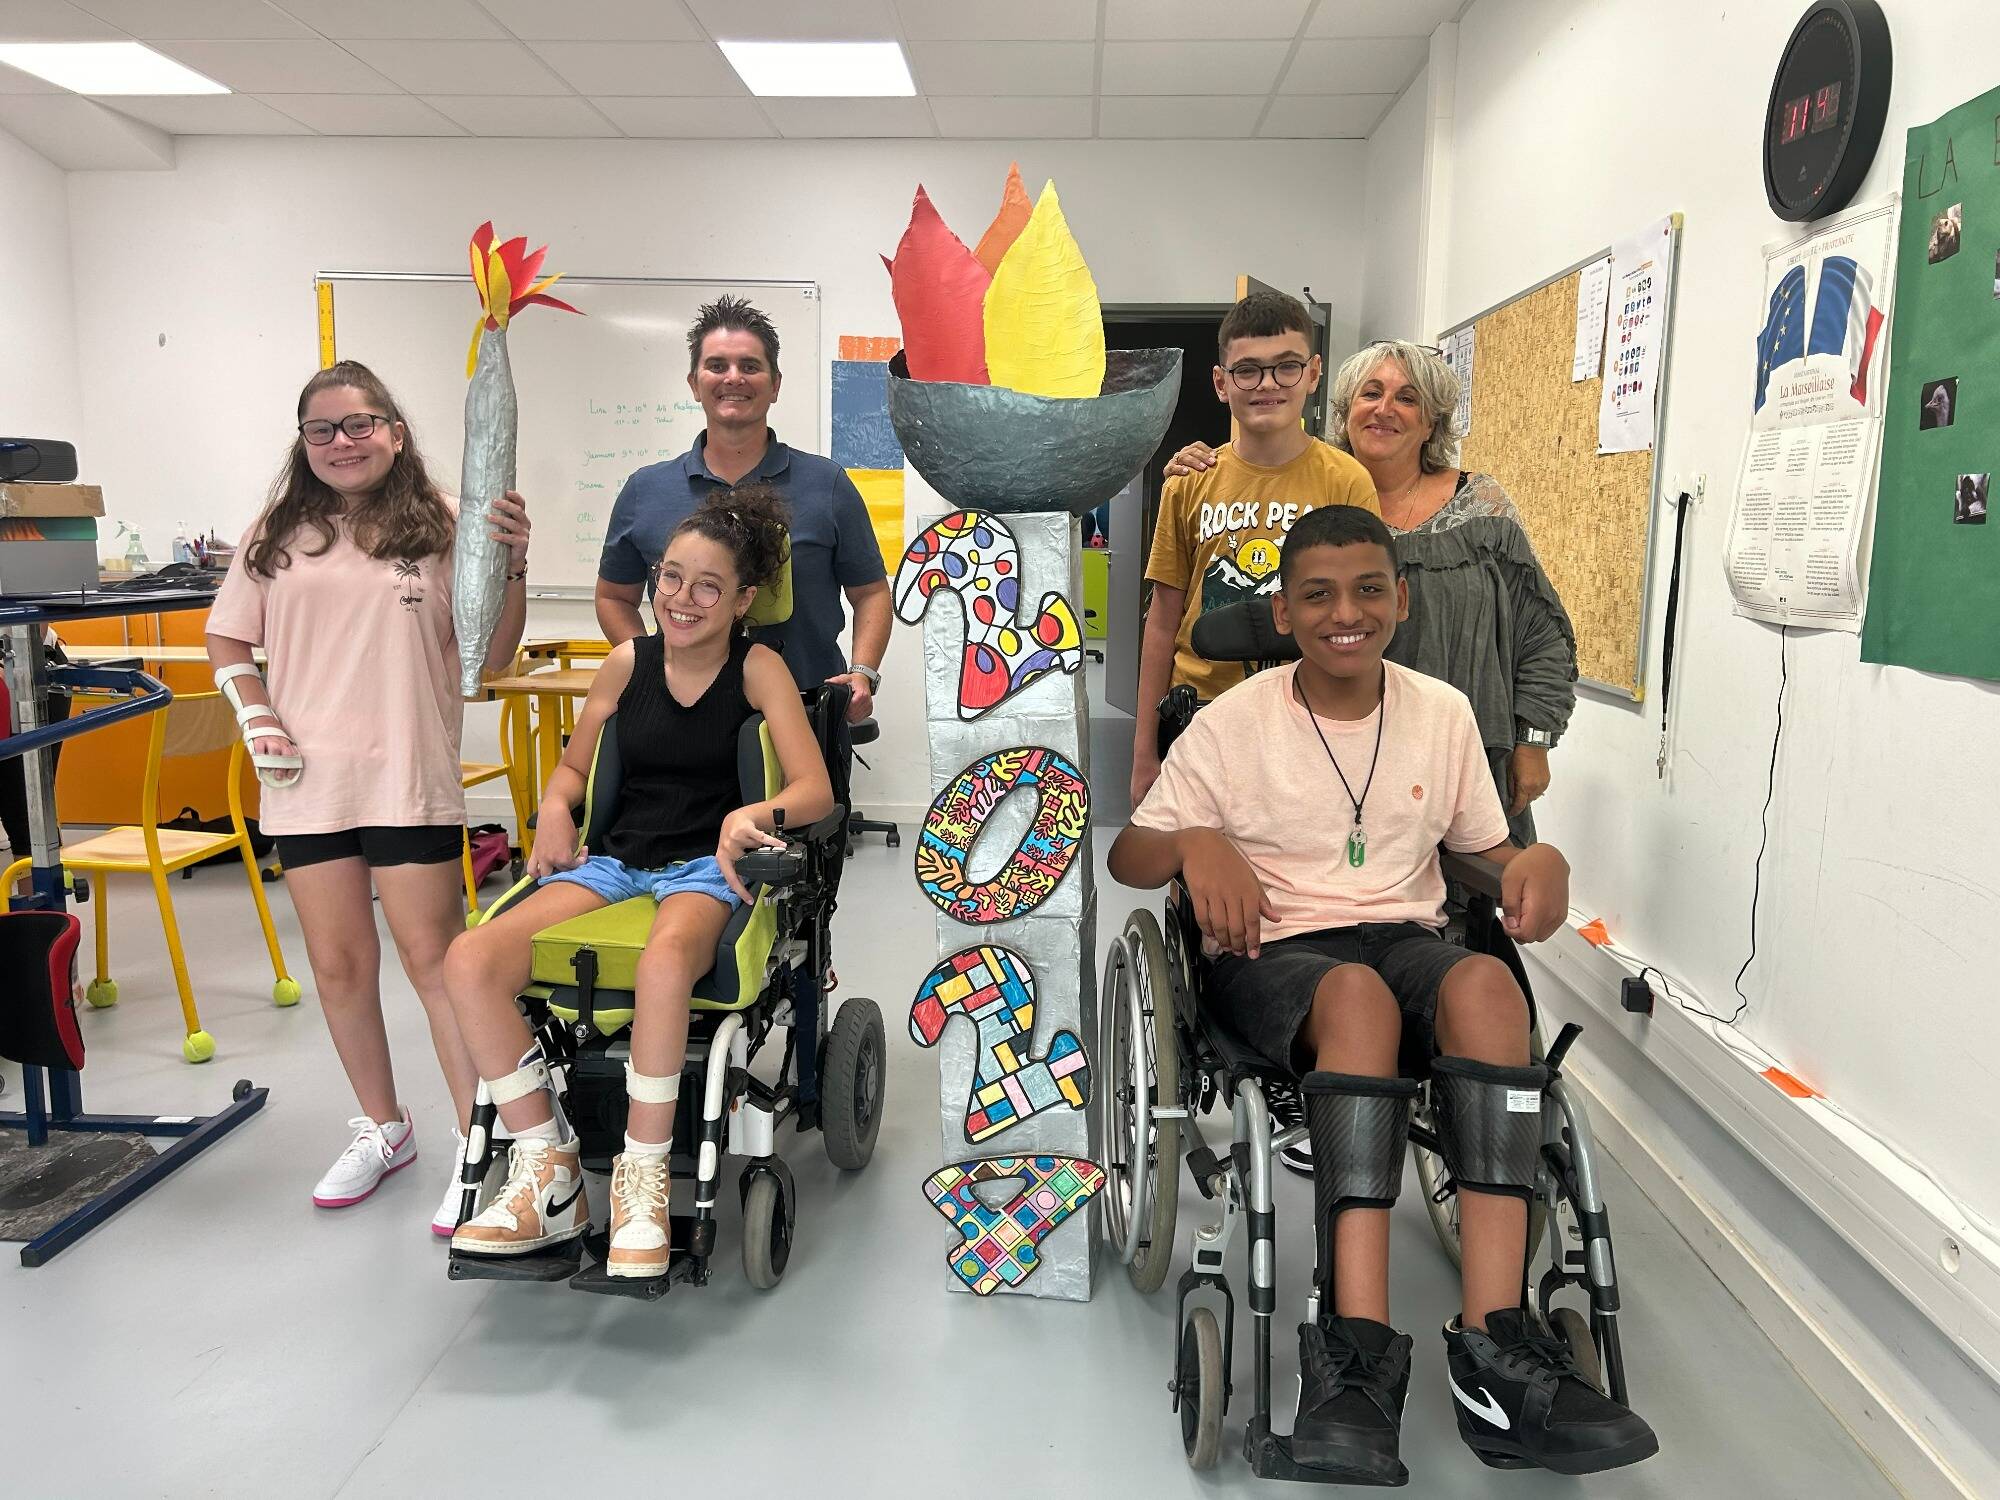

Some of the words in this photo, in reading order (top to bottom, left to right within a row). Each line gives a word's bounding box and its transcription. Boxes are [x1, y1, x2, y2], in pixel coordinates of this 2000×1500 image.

[1918, 136, 1958, 199] LA
[1780, 384, 1789, 399] La
[1790, 373, 1835, 397] Marseillaise
[1200, 501, 1260, 544] ROCK
